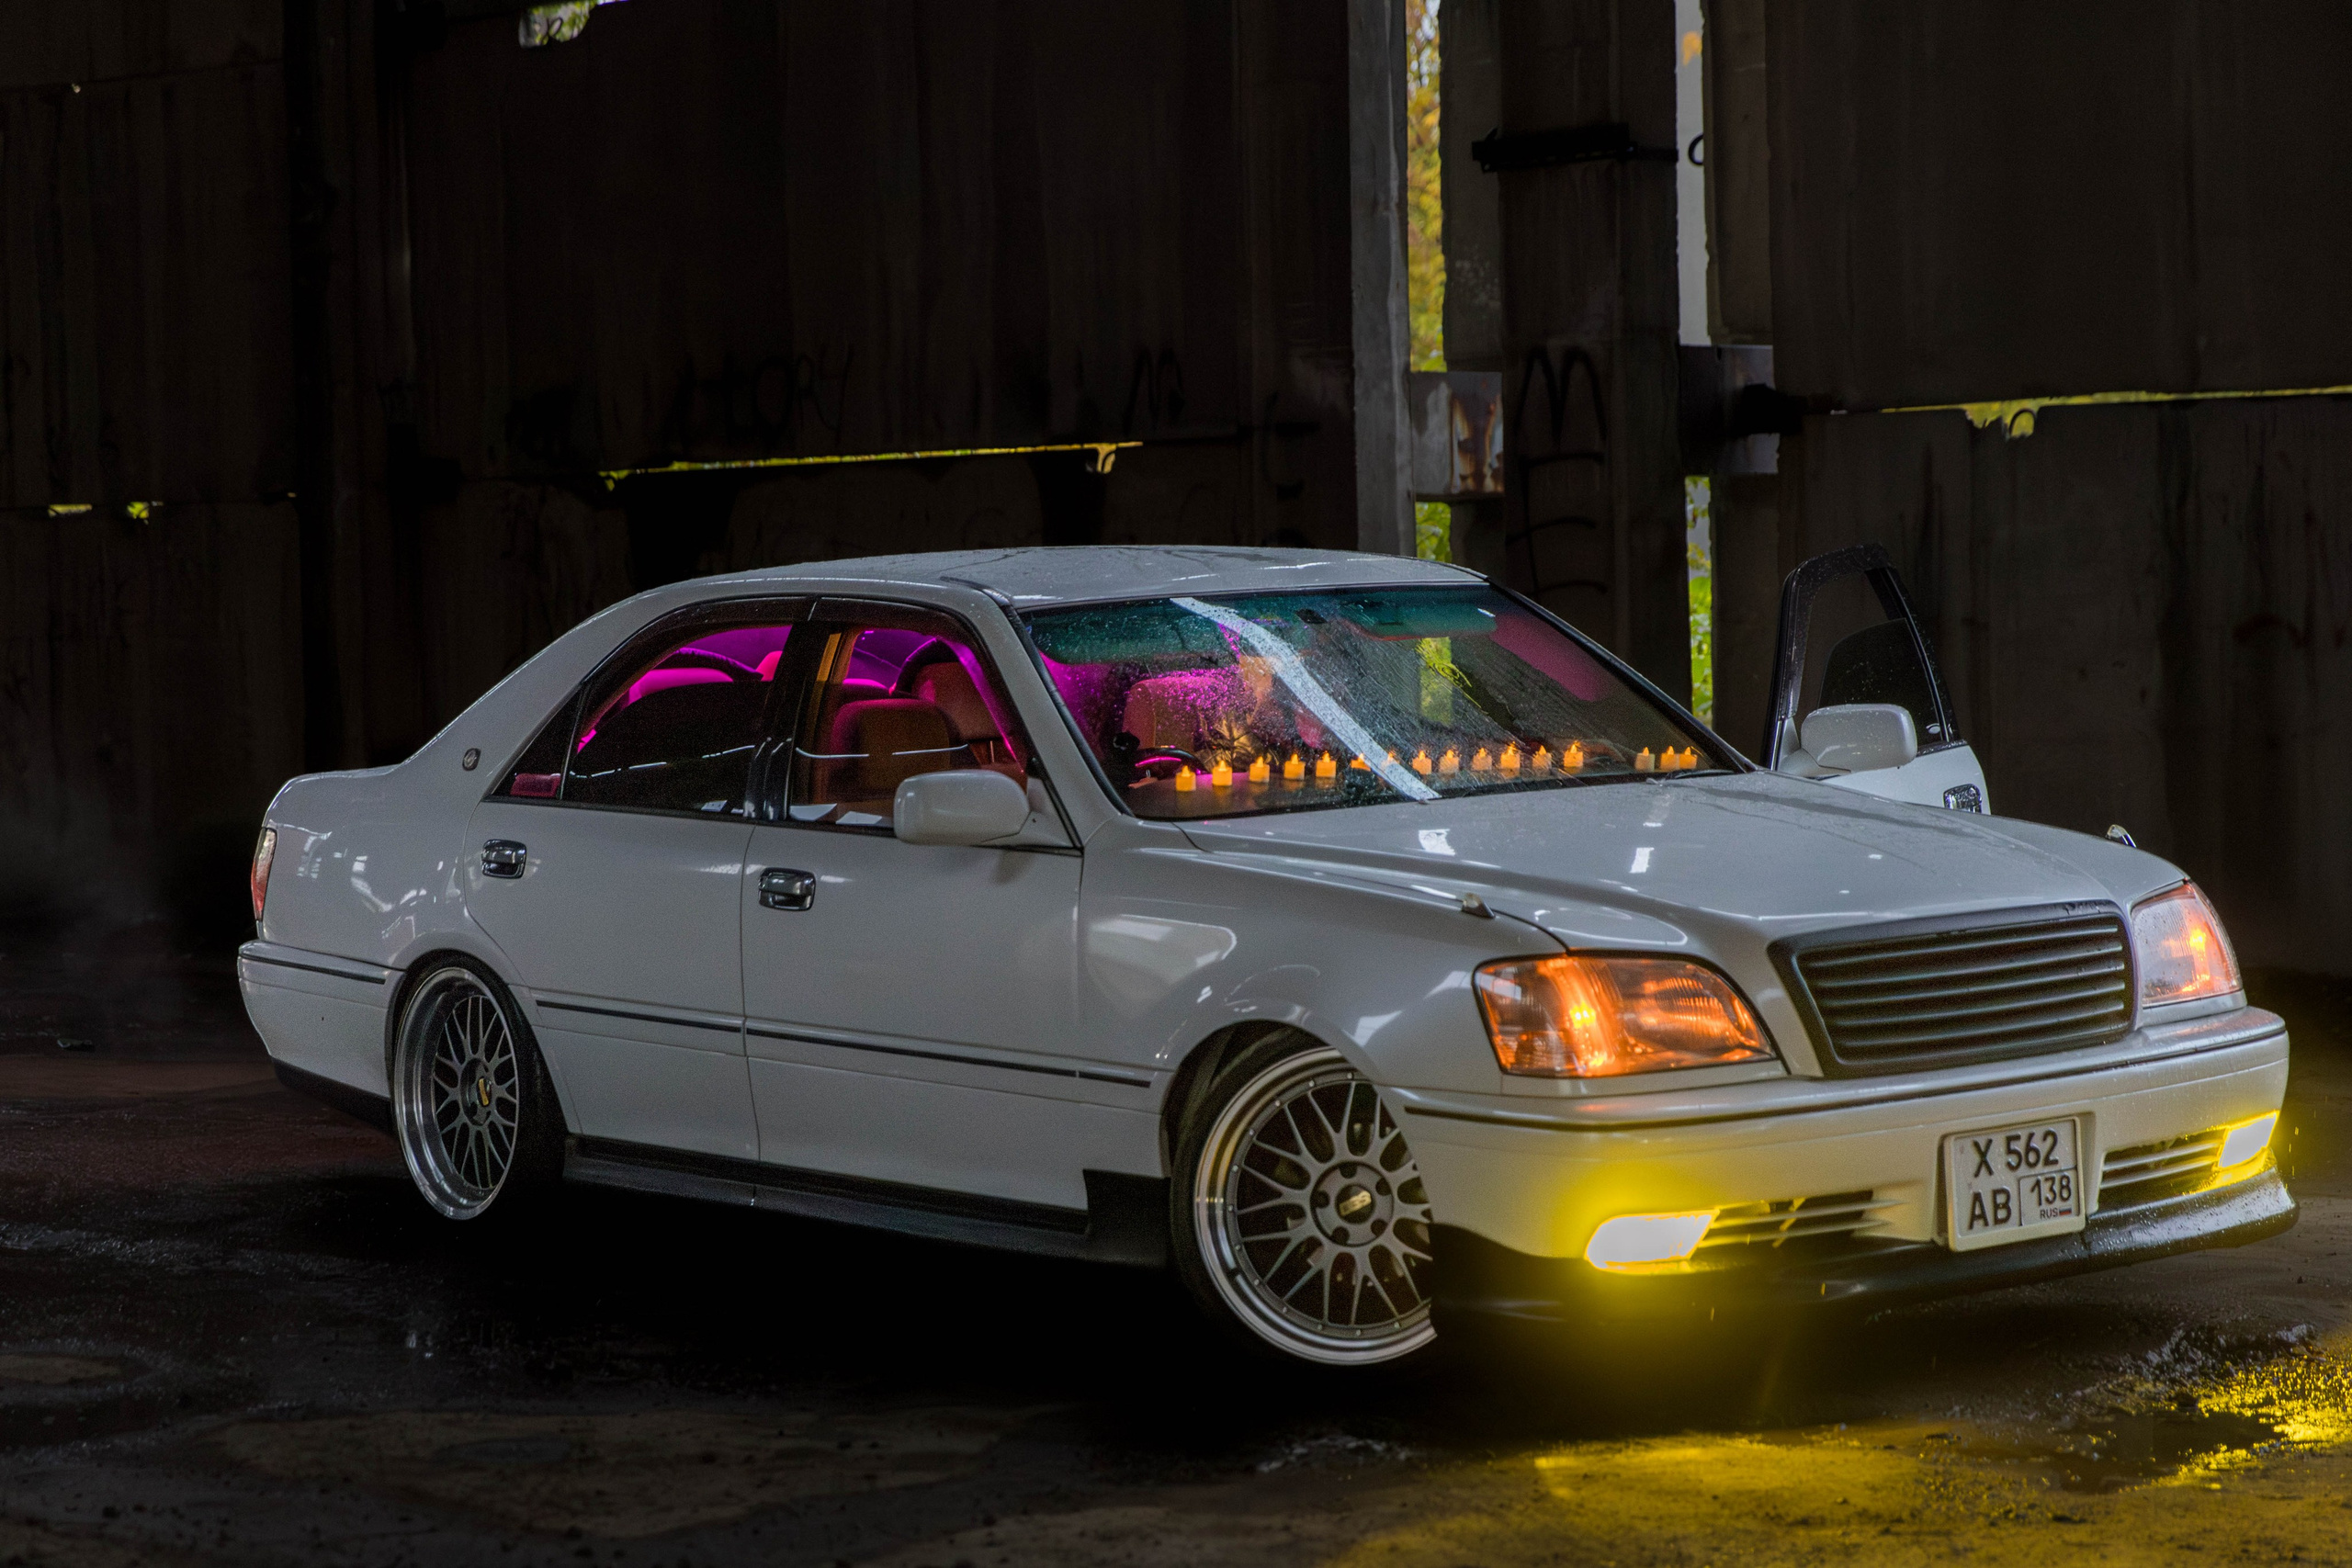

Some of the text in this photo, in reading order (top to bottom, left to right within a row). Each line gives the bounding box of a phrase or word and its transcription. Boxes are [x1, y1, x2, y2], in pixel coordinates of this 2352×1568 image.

[1973, 1129, 2059, 1178] X 562
[1968, 1187, 2012, 1230] AB
[2030, 1174, 2072, 1207] 138
[2040, 1207, 2059, 1220] RUS
